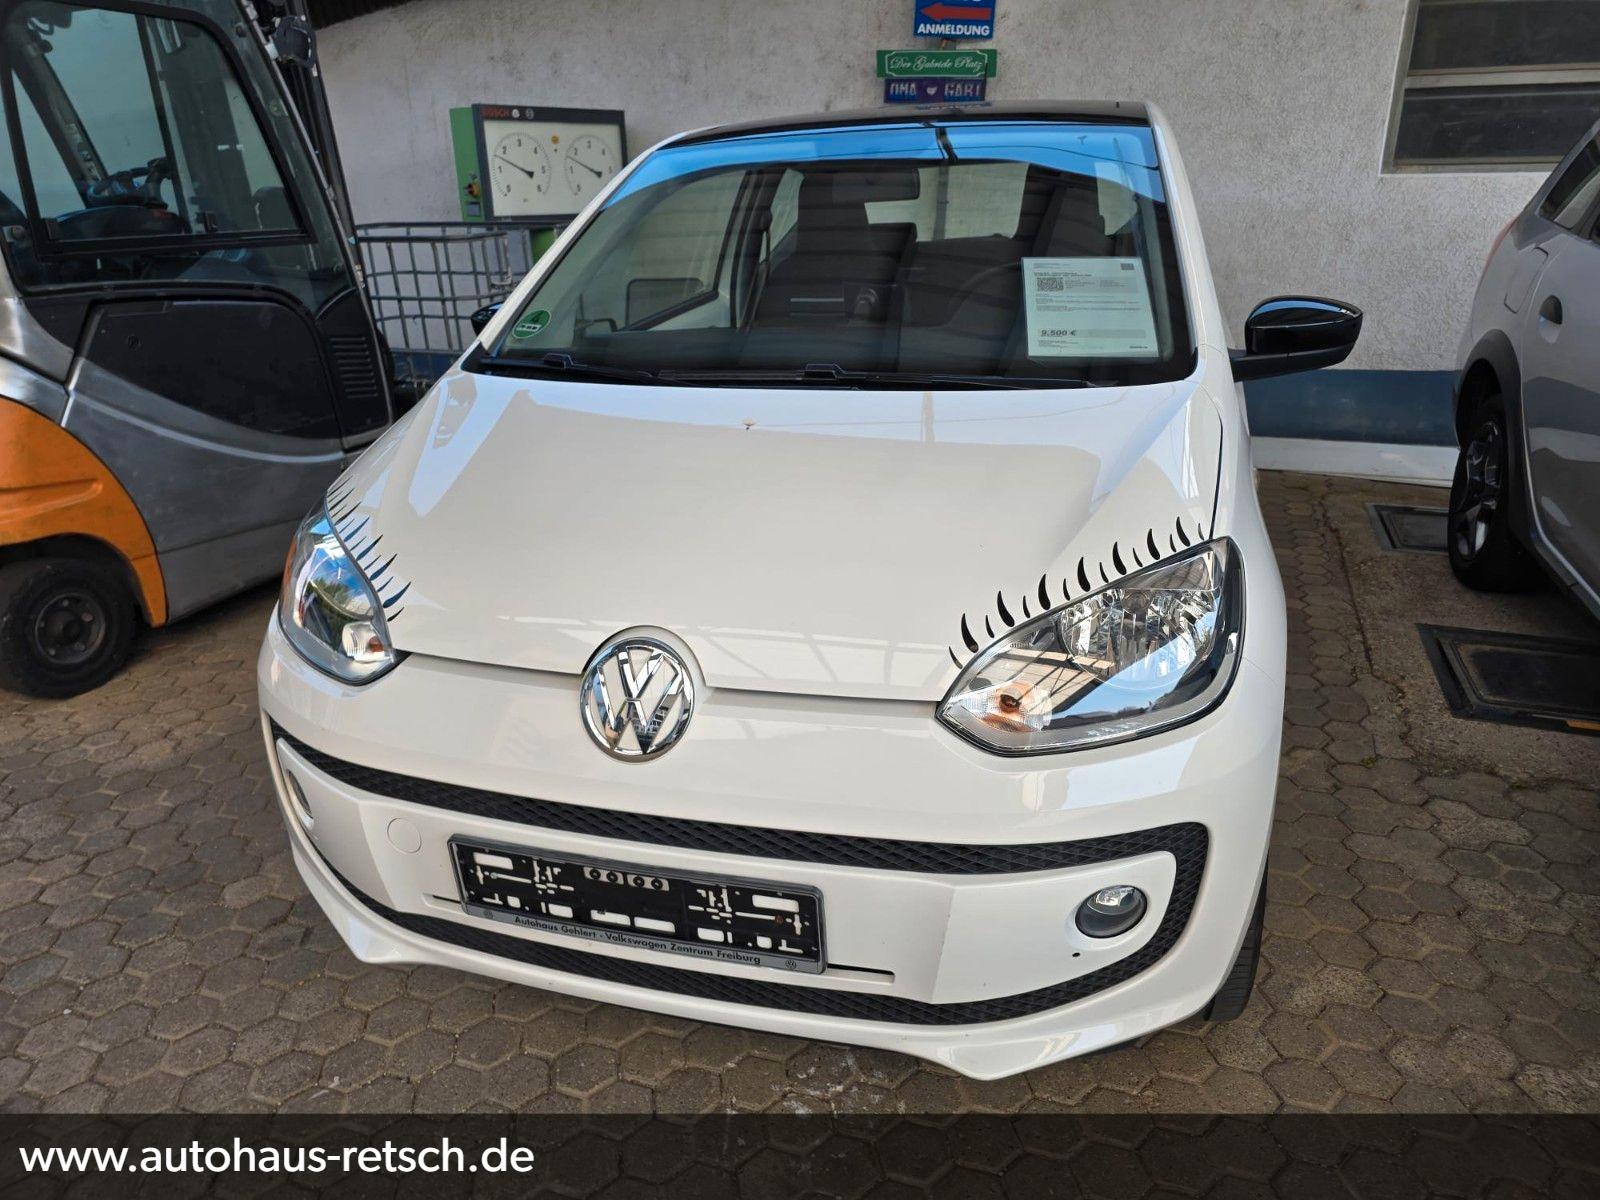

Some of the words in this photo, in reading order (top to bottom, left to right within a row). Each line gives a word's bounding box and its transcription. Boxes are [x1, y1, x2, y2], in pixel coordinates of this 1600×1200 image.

[917, 23, 990, 36] ANMELDUNG
[889, 57, 911, 69] Der
[954, 56, 982, 73] Platz
[889, 82, 917, 96] OMA
[1041, 329, 1068, 337] 9.500
[1070, 329, 1077, 337] €
[515, 916, 558, 931] Autohaus
[605, 932, 667, 950] Volkswagen
[670, 943, 713, 957] Zentrum
[717, 951, 761, 965] Freiburg
